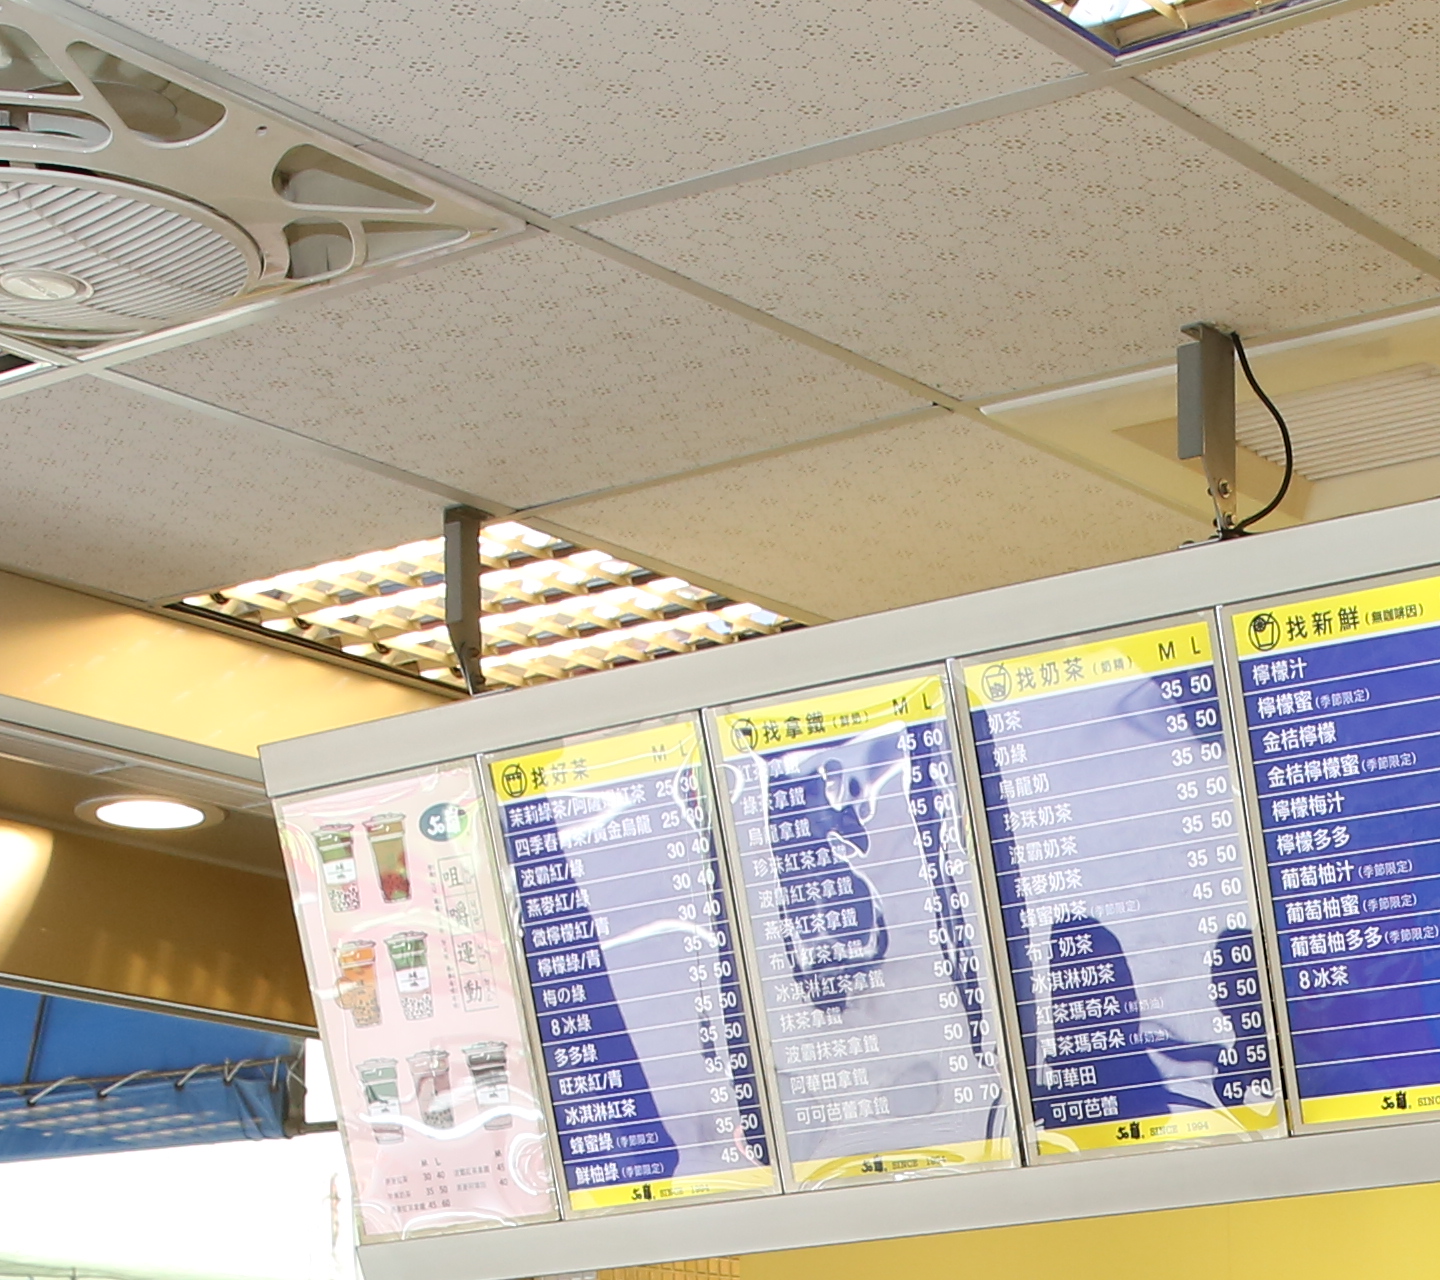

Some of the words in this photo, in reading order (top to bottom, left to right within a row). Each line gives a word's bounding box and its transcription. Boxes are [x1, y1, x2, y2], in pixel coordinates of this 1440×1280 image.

[1286, 607, 1360, 641] 找新鮮
[1016, 656, 1085, 692] 找奶茶
[1158, 641, 1175, 661] M
[1191, 636, 1201, 654] L
[1252, 658, 1308, 686] 檸檬汁
[988, 710, 1022, 733] 奶茶
[1161, 680, 1182, 699] 35
[1190, 674, 1211, 693] 50
[1262, 721, 1336, 753] 金桔檸檬
[993, 743, 1028, 767] 奶綠
[1003, 803, 1073, 832] 珍珠奶茶
[1272, 791, 1345, 822] 檸檬梅汁
[1009, 836, 1078, 865] 波霸奶茶
[1277, 826, 1350, 856] 檸檬多多
[1014, 869, 1083, 897] 燕麥奶茶
[764, 909, 858, 940] 燕麥紅茶拿鐵
[1025, 934, 1093, 962] 布丁奶茶
[1030, 964, 1115, 994] 冰淇淋奶茶
[779, 1007, 843, 1032] 抹茶拿鐵
[1036, 997, 1121, 1025] 紅茶瑪奇朵
[555, 1045, 598, 1067] 多多綠
[790, 1069, 869, 1094] 阿華田拿鐵
[1046, 1066, 1097, 1090] 阿華田
[954, 1086, 973, 1103] 50
[980, 1083, 1000, 1099] 70
[565, 1099, 637, 1126] 冰淇淋紅茶
[1051, 1096, 1118, 1122] 可可芭蕾
[721, 1148, 739, 1163] 45
[746, 1145, 763, 1160] 60
